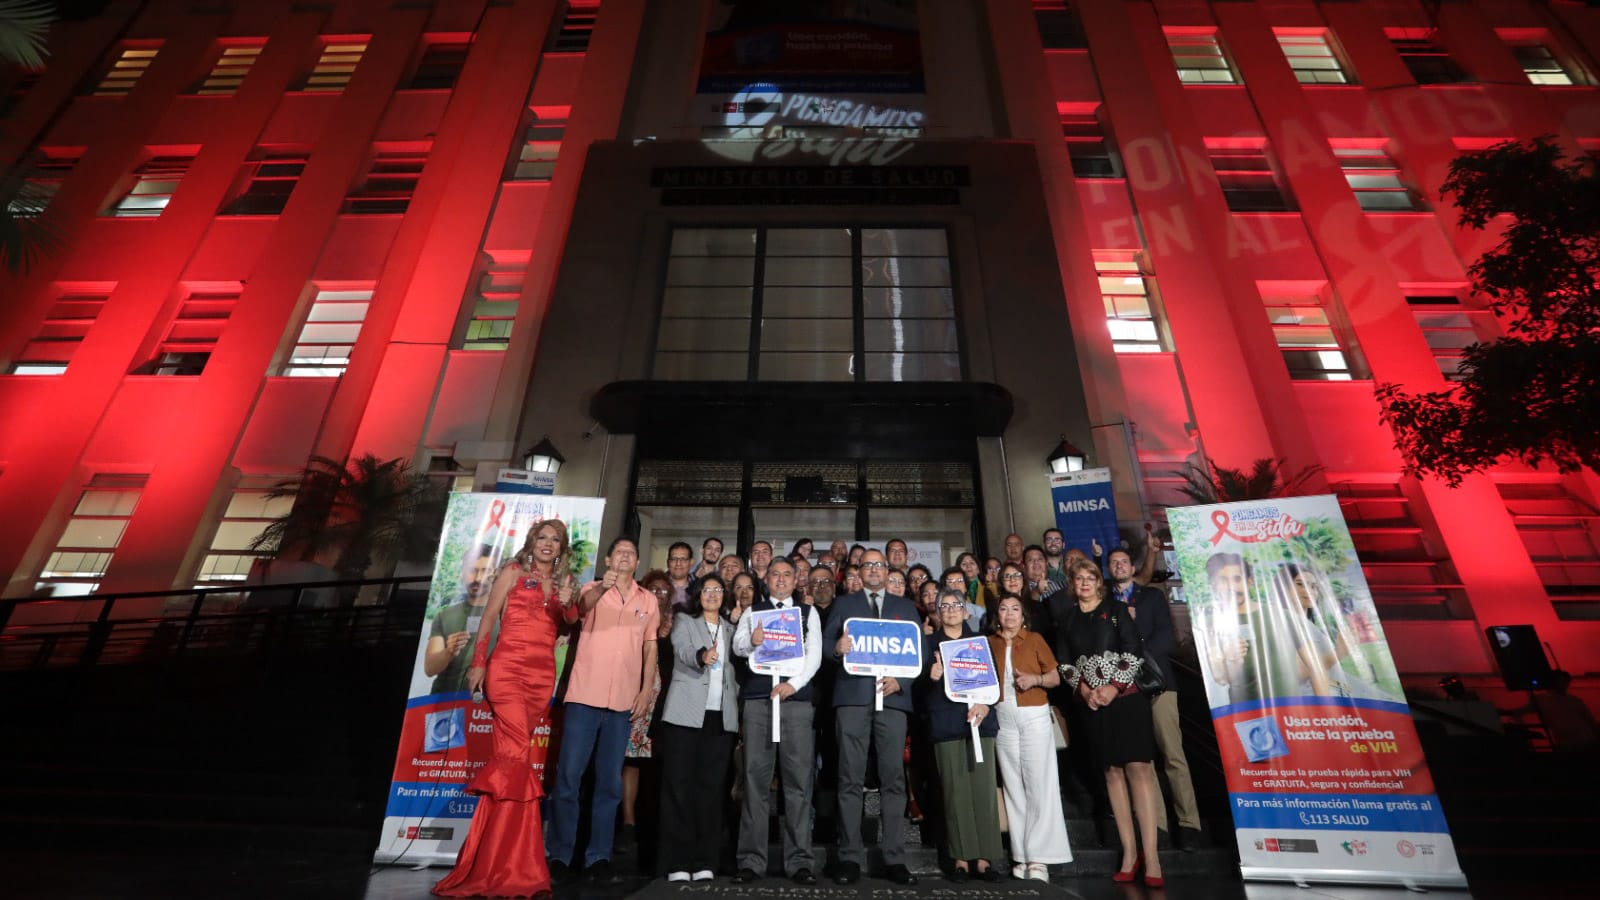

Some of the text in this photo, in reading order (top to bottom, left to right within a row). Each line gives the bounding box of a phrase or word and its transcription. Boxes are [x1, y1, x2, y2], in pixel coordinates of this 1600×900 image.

[663, 168, 956, 184] MINISTERIO DE SALUD
[1059, 498, 1110, 513] MINSA
[847, 634, 917, 655] MINSA
[1283, 715, 1368, 727] Usa condón,
[1286, 729, 1395, 742] hazte la prueba
[1350, 742, 1398, 753] de VIH
[448, 760, 463, 768] que
[429, 770, 468, 778] GRATUITA,
[1240, 768, 1412, 778] Recuerda que la prueba rápida para VIH
[1264, 780, 1309, 789] GRATUITA,
[1310, 781, 1339, 790] segura
[1341, 782, 1347, 790] y
[1349, 780, 1404, 789] confidencial
[397, 787, 418, 797] Para
[420, 787, 438, 797] más
[458, 804, 474, 813] 113
[1236, 798, 1432, 812] Para más información llama gratis al
[1309, 815, 1369, 826] 113 SALUD
